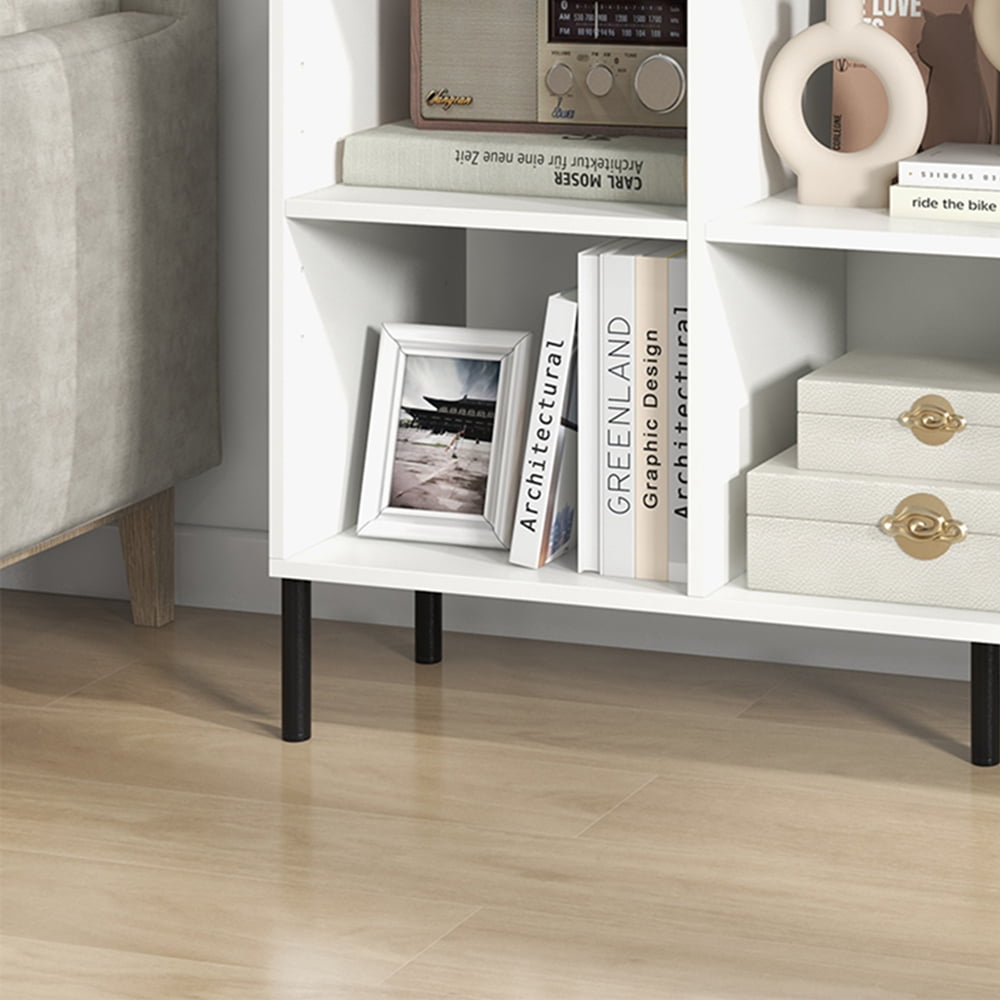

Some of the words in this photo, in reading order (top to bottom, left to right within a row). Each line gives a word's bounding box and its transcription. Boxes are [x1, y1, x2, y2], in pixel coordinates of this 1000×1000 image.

[560, 27, 571, 35] FM
[454, 150, 479, 165] Zeit
[483, 152, 512, 165] neue
[517, 154, 545, 166] eine
[547, 155, 568, 170] für
[571, 157, 644, 174] Architektur
[553, 170, 601, 188] MOSER
[607, 174, 642, 191] CARL
[920, 171, 974, 180] STORIES
[911, 196, 939, 209] ride
[942, 198, 965, 211] the
[968, 199, 998, 212] bike
[643, 329, 662, 408] Design
[607, 316, 631, 515] GREENLAND
[520, 339, 564, 532] Architectural
[643, 419, 662, 509] Graphic
